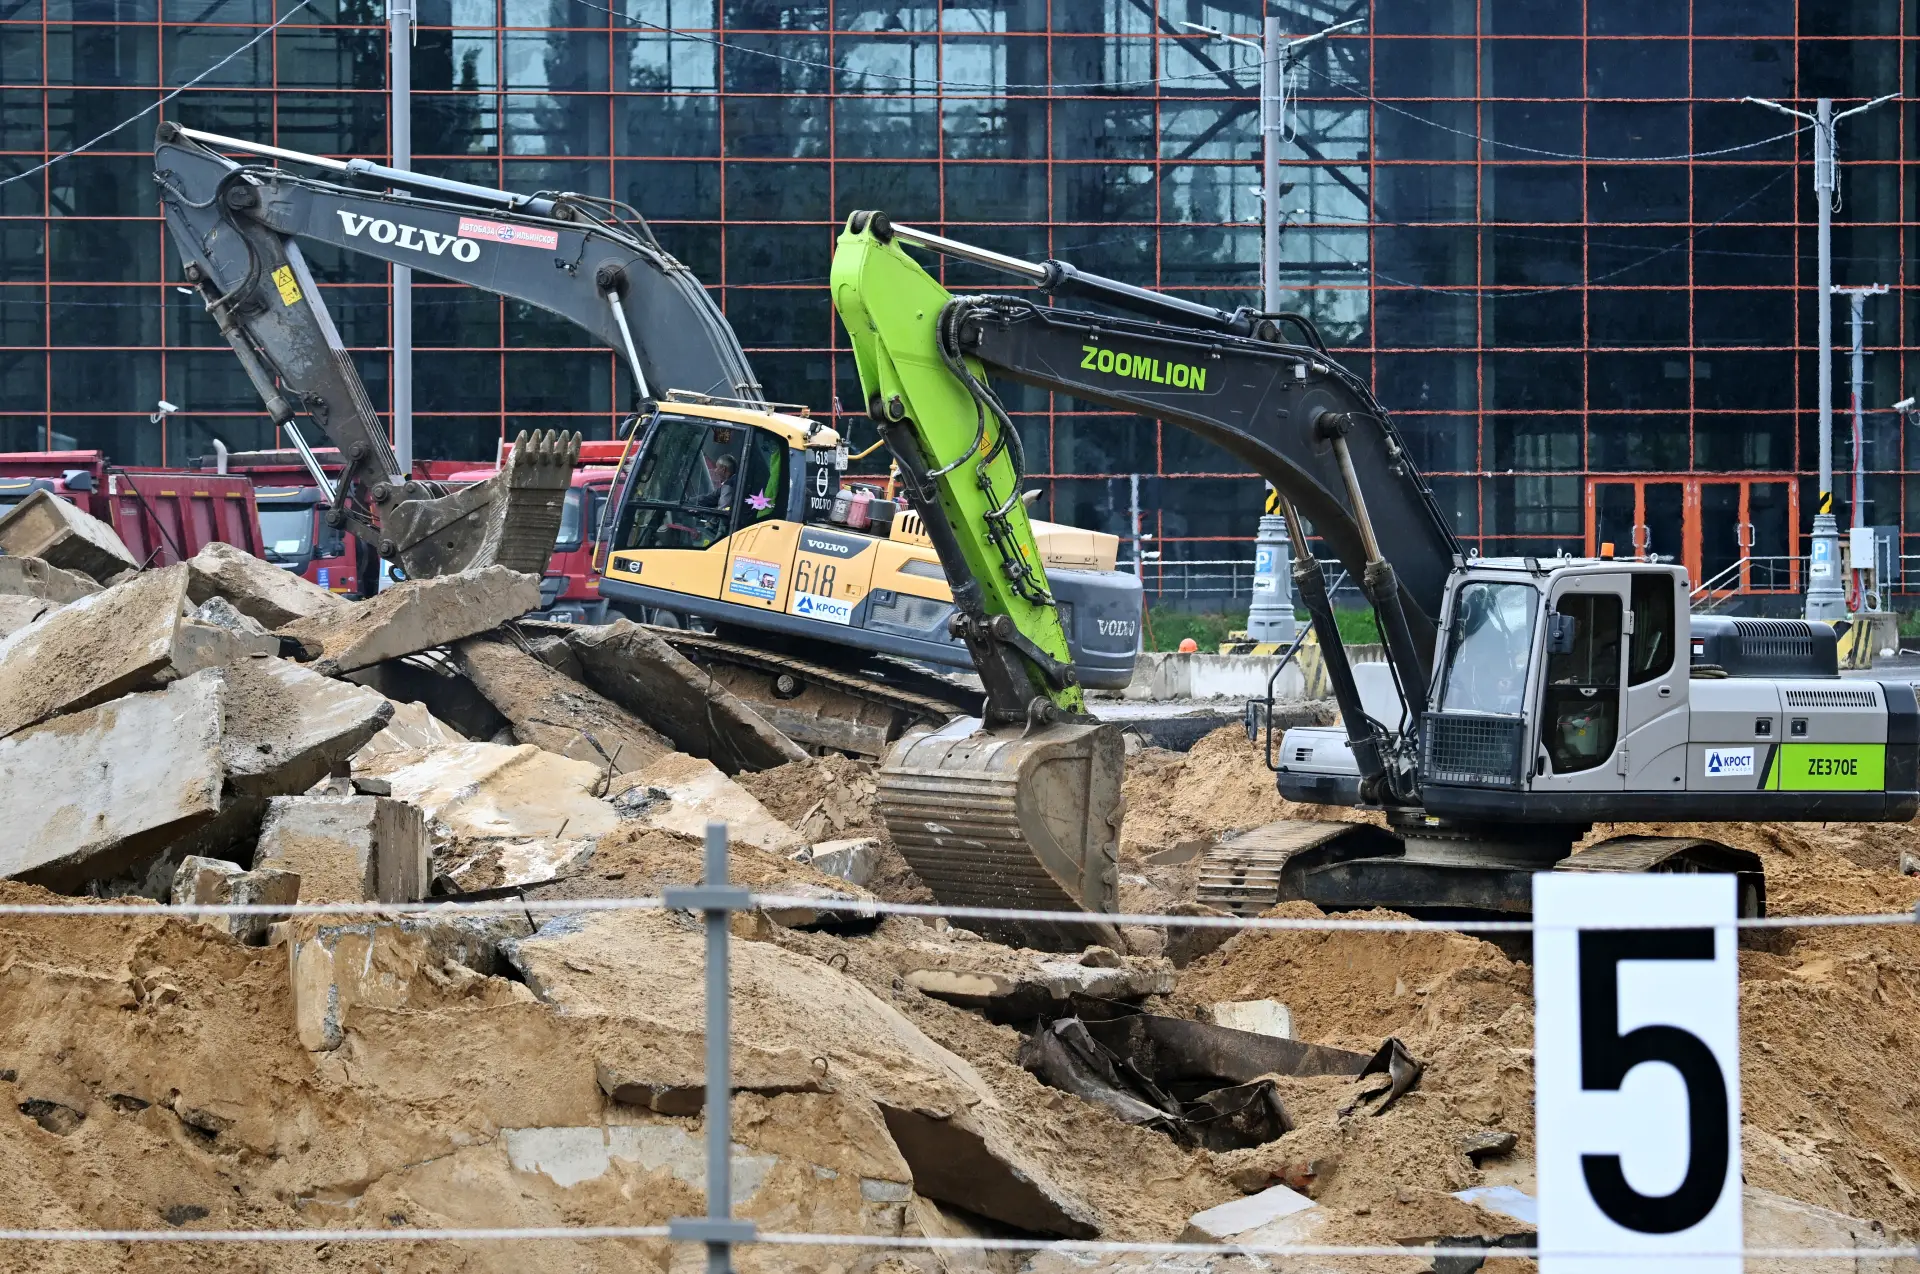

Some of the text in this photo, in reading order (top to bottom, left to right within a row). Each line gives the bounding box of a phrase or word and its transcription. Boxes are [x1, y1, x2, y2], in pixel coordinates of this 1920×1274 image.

[336, 210, 481, 263] VOLVO
[460, 222, 495, 236] АВТОБАЗА
[516, 231, 556, 244] ИЛЬИНСКОЕ
[1080, 345, 1206, 391] ZOOMLION
[815, 450, 829, 466] 618
[811, 497, 832, 511] VOLVO
[807, 539, 849, 554] VOLVO
[1814, 542, 1827, 561] P
[1256, 551, 1270, 572] P
[794, 559, 837, 598] 618
[815, 602, 849, 617] КРОСТ
[1096, 619, 1136, 637] VOLVO
[1723, 755, 1752, 767] КРОСТ
[1808, 758, 1858, 776] ZE370E
[1577, 927, 1730, 1235] 5
